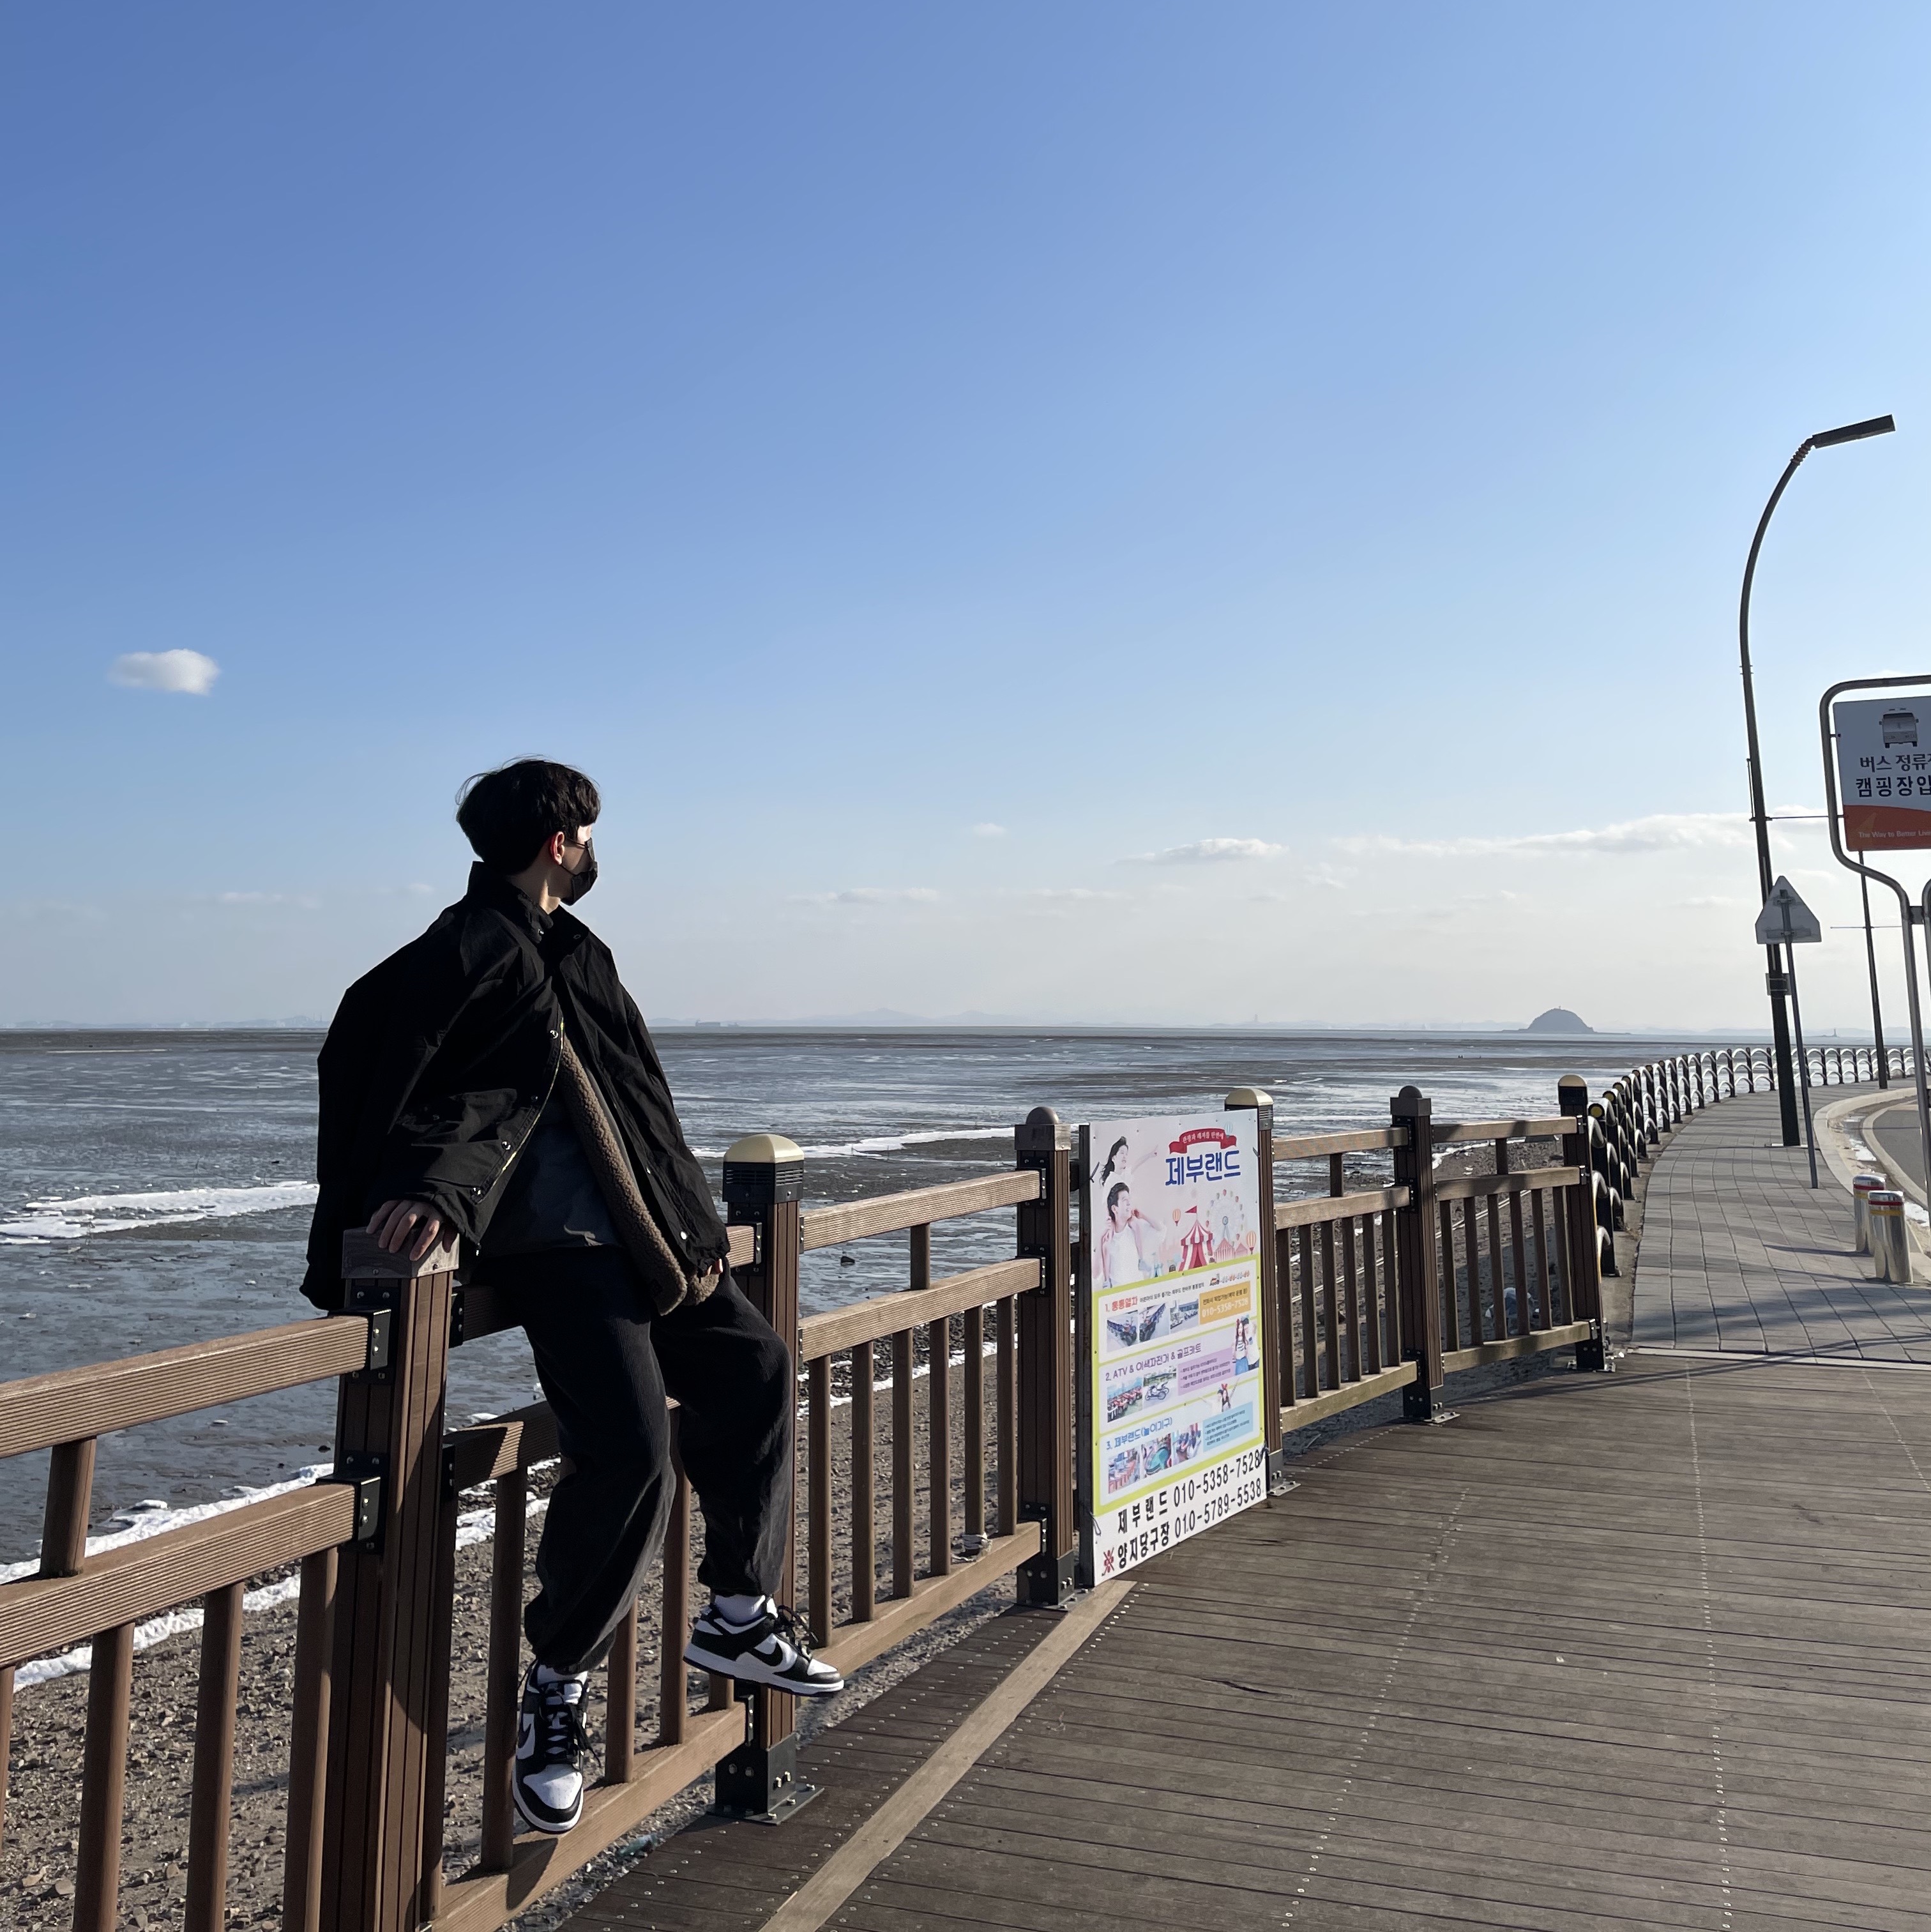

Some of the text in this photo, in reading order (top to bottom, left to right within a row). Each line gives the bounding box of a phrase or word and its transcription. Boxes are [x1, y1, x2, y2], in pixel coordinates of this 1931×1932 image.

[1859, 756, 1892, 773] 버스
[1165, 1150, 1241, 1186] 제부랜드
[1105, 1373, 1111, 1381] 2.
[1113, 1366, 1128, 1379] ATV
[1129, 1365, 1134, 1373] &
[1170, 1351, 1176, 1360] &
[1174, 1449, 1260, 1507] 010-5358-7528
[1117, 1477, 1261, 1569] 양지당구장 010-5789-5538
